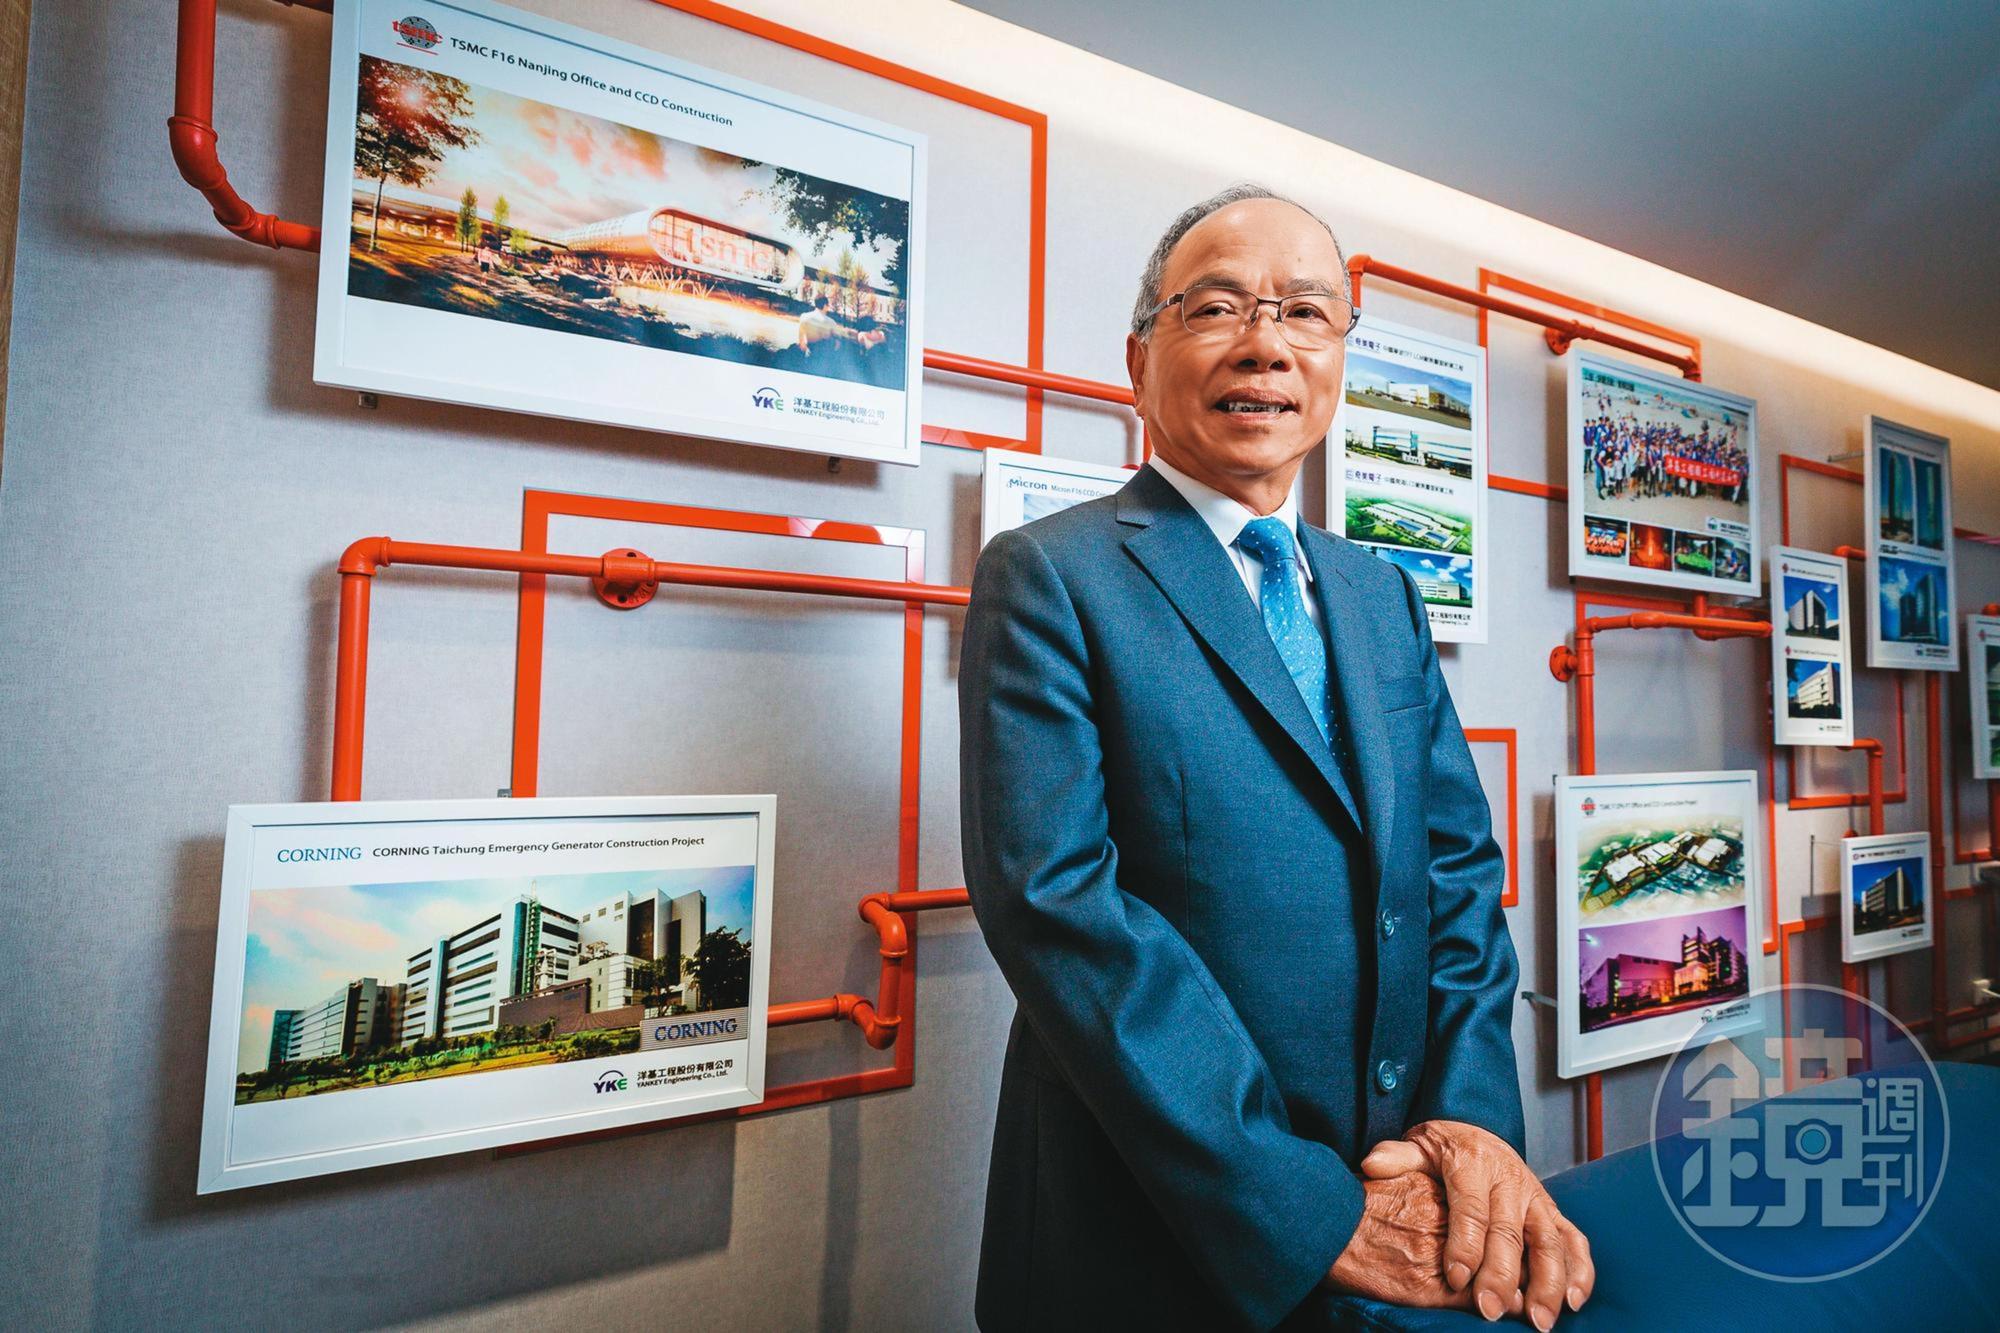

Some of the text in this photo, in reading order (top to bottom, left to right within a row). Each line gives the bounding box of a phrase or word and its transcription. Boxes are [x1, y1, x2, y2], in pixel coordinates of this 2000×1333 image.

[450, 37, 733, 126] TSMC F16 Nanjing Office and CCD Construction
[752, 395, 784, 411] YKE
[793, 397, 885, 420] 洋基工程股份有限公司
[793, 407, 817, 417] YANKEY
[818, 411, 855, 423] Engineering
[1010, 478, 1047, 491] Micron
[1051, 484, 1071, 493] Micron
[1083, 488, 1095, 497] CCD
[277, 847, 362, 863] CORNING
[373, 837, 705, 857] CORNING Taichung Emergency Generator Construction Project
[655, 1018, 738, 1041] CORNING
[637, 1059, 733, 1080] 洋基工程股份有限公司
[593, 1078, 628, 1094] YKE
[637, 1079, 662, 1088] YANKEY
[664, 1075, 702, 1086] Engineering
[703, 1072, 715, 1080] Co.,
